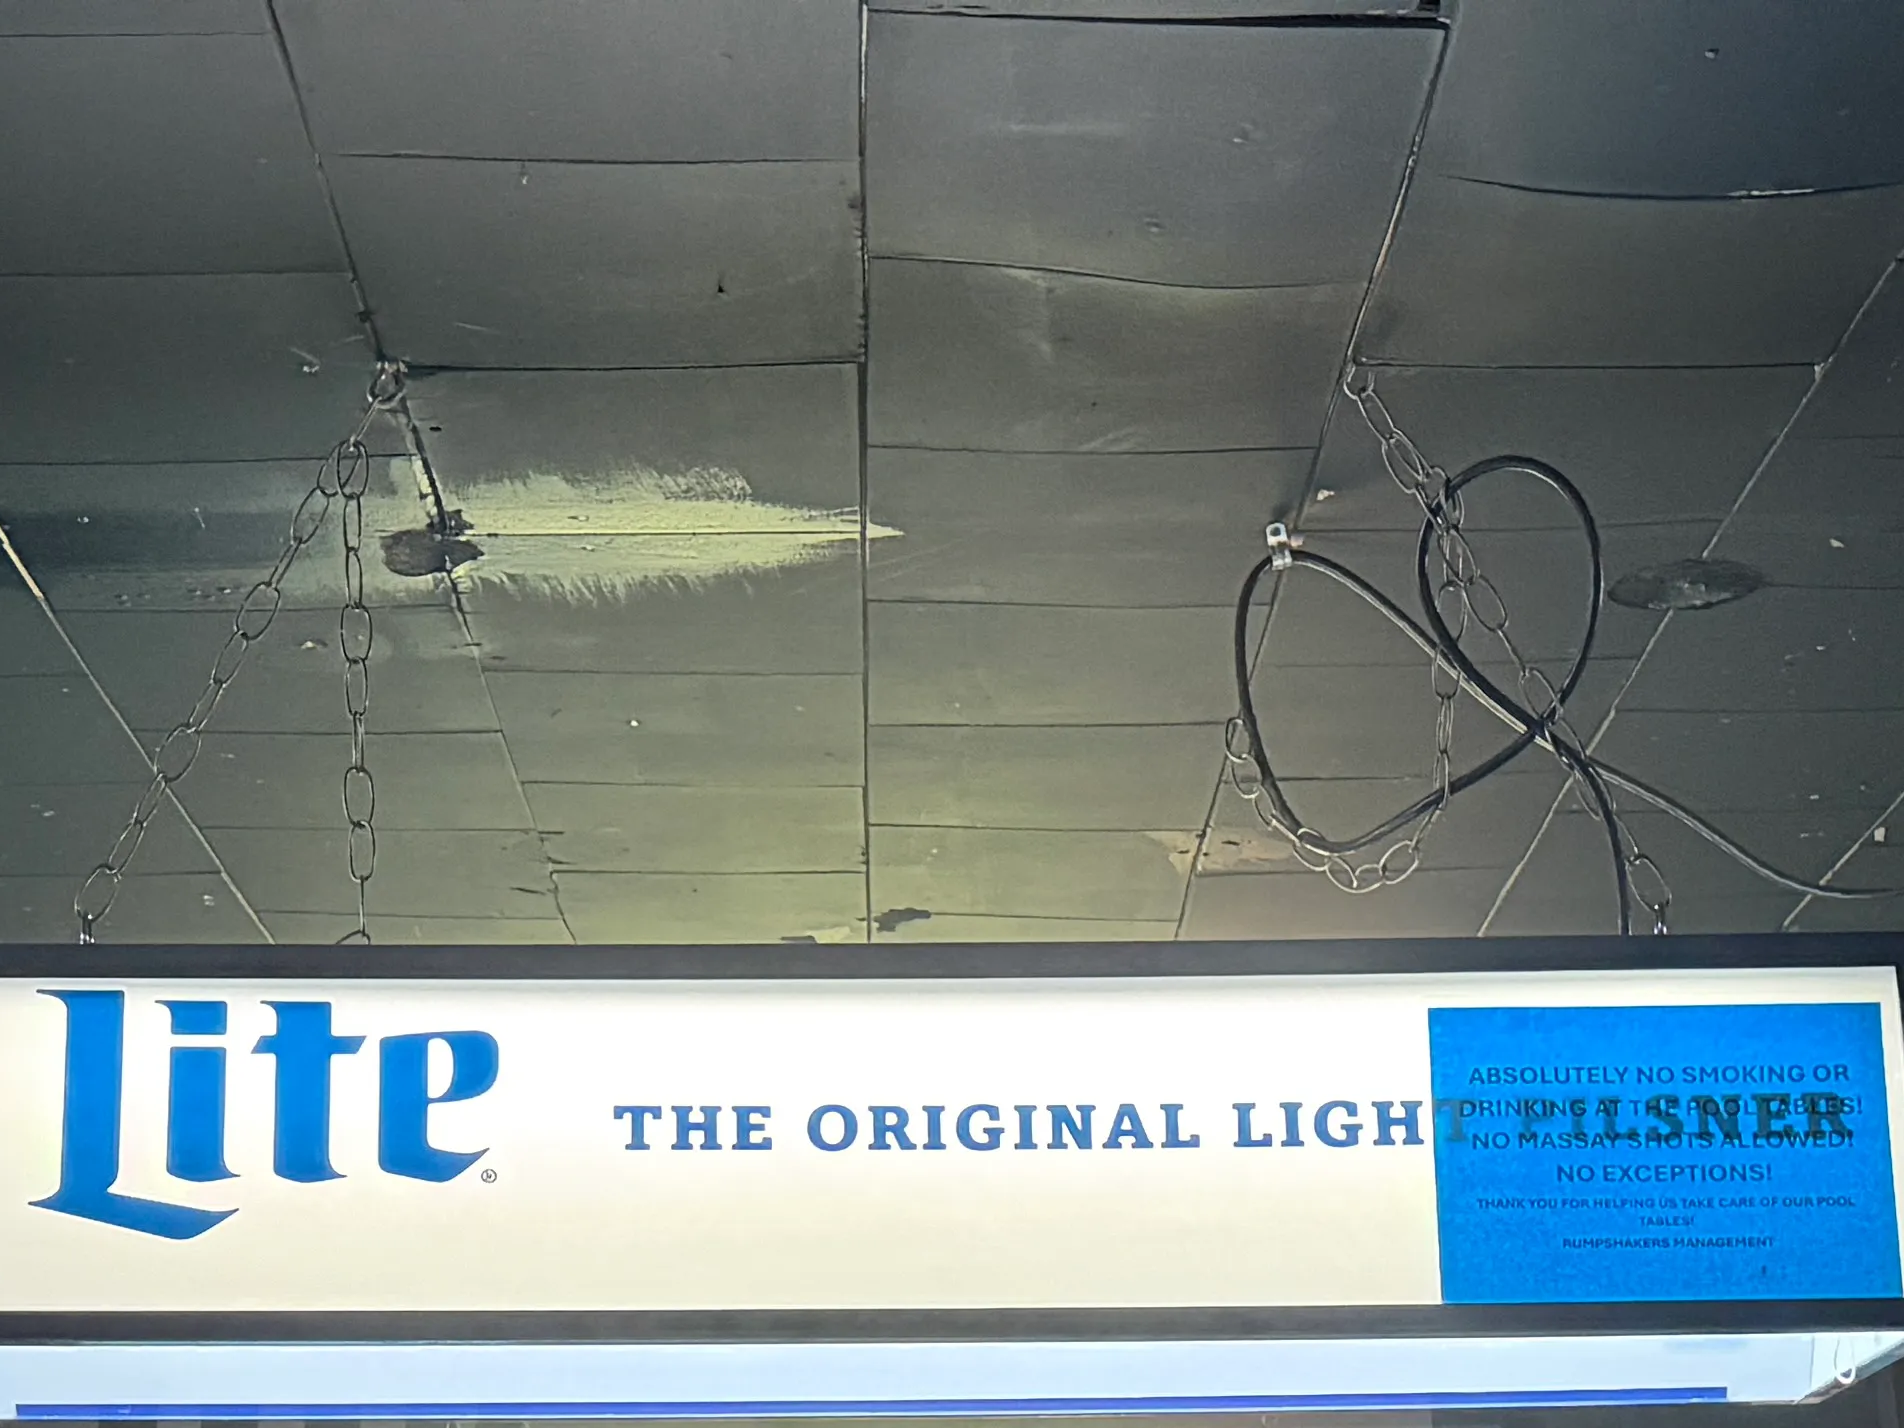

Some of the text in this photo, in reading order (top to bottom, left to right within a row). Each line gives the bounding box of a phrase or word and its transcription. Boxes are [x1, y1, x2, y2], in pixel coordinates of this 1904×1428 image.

[1468, 1063, 1850, 1086] ABSOLUTELY NO SMOKING OR
[28, 988, 499, 1239] Lite
[1459, 1095, 1864, 1118] DRINKING AT THE POOL TABLES!
[614, 1104, 772, 1151] THE
[807, 1102, 1201, 1151] ORIGINAL
[1472, 1128, 1854, 1150] NO MASSAY SHOTS ALLOWED!
[1556, 1163, 1772, 1183] NO EXCEPTIONS!
[1476, 1195, 1855, 1210] THANK YOU FOR HELPING US TAKE CARE OF OUR POOL
[1638, 1215, 1695, 1227] TABLES!
[1562, 1236, 1774, 1250] RUMPSHAKERS MANAGEMENT
